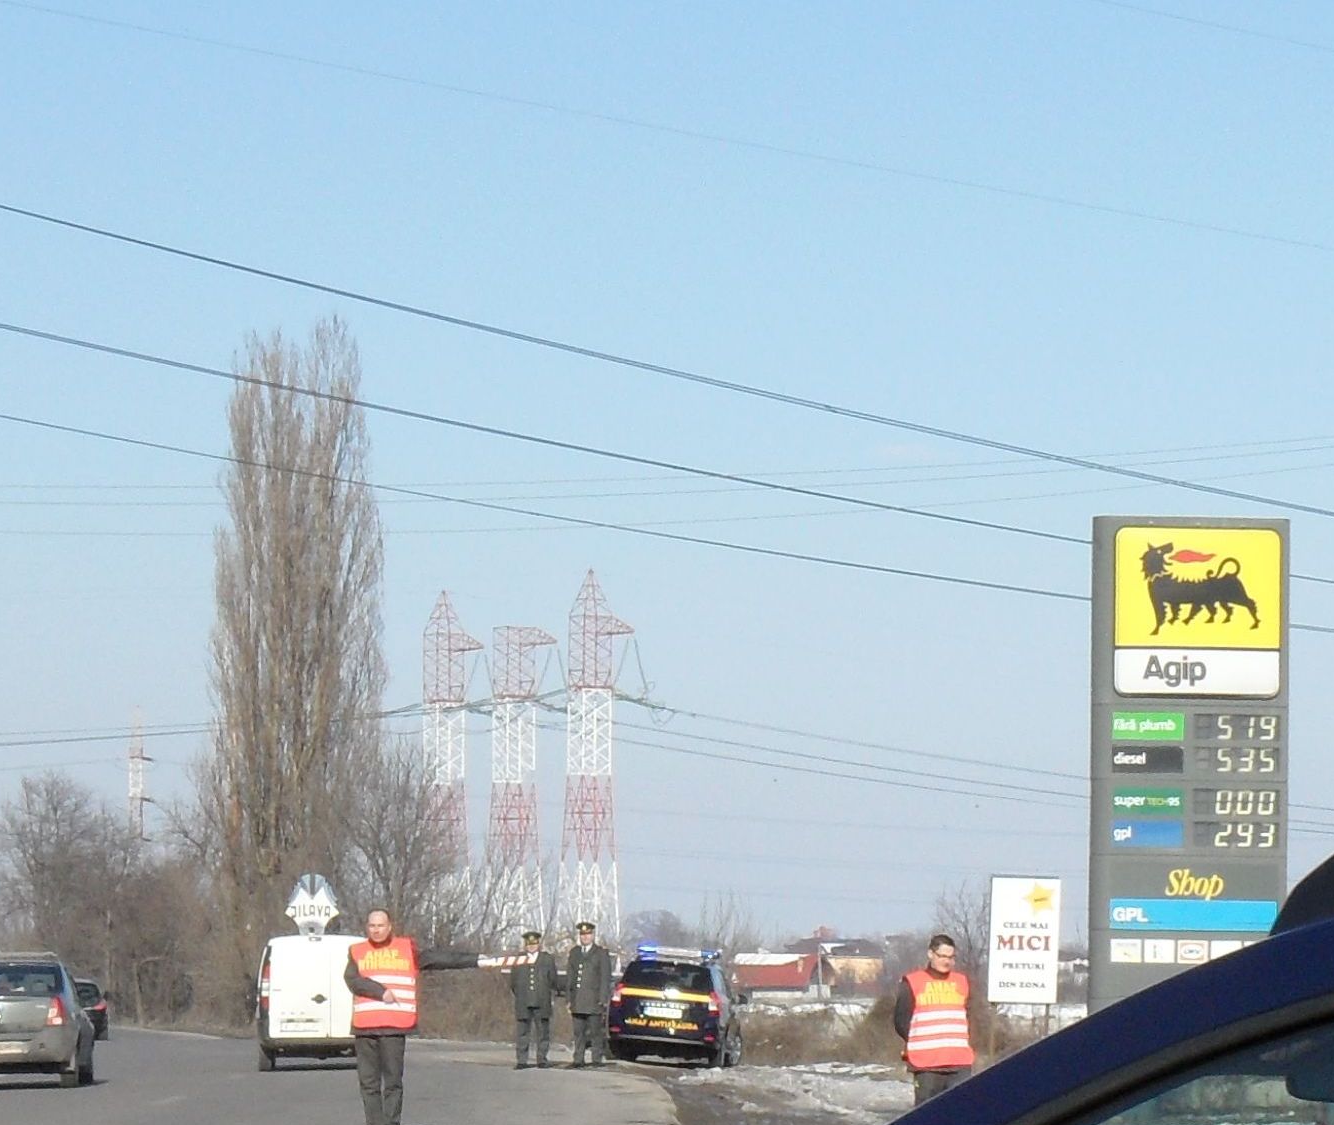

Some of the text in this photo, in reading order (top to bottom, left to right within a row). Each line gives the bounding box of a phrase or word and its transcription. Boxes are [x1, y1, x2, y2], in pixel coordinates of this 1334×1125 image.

[1143, 655, 1207, 687] Agip
[1113, 752, 1147, 765] diesel
[1114, 796, 1145, 808] super
[1113, 826, 1132, 841] gpl
[1165, 869, 1224, 901] Shop
[1112, 907, 1149, 922] GPL
[1030, 922, 1048, 930] MAI
[996, 935, 1051, 951] MICI
[998, 981, 1046, 989] DIN ZONA
